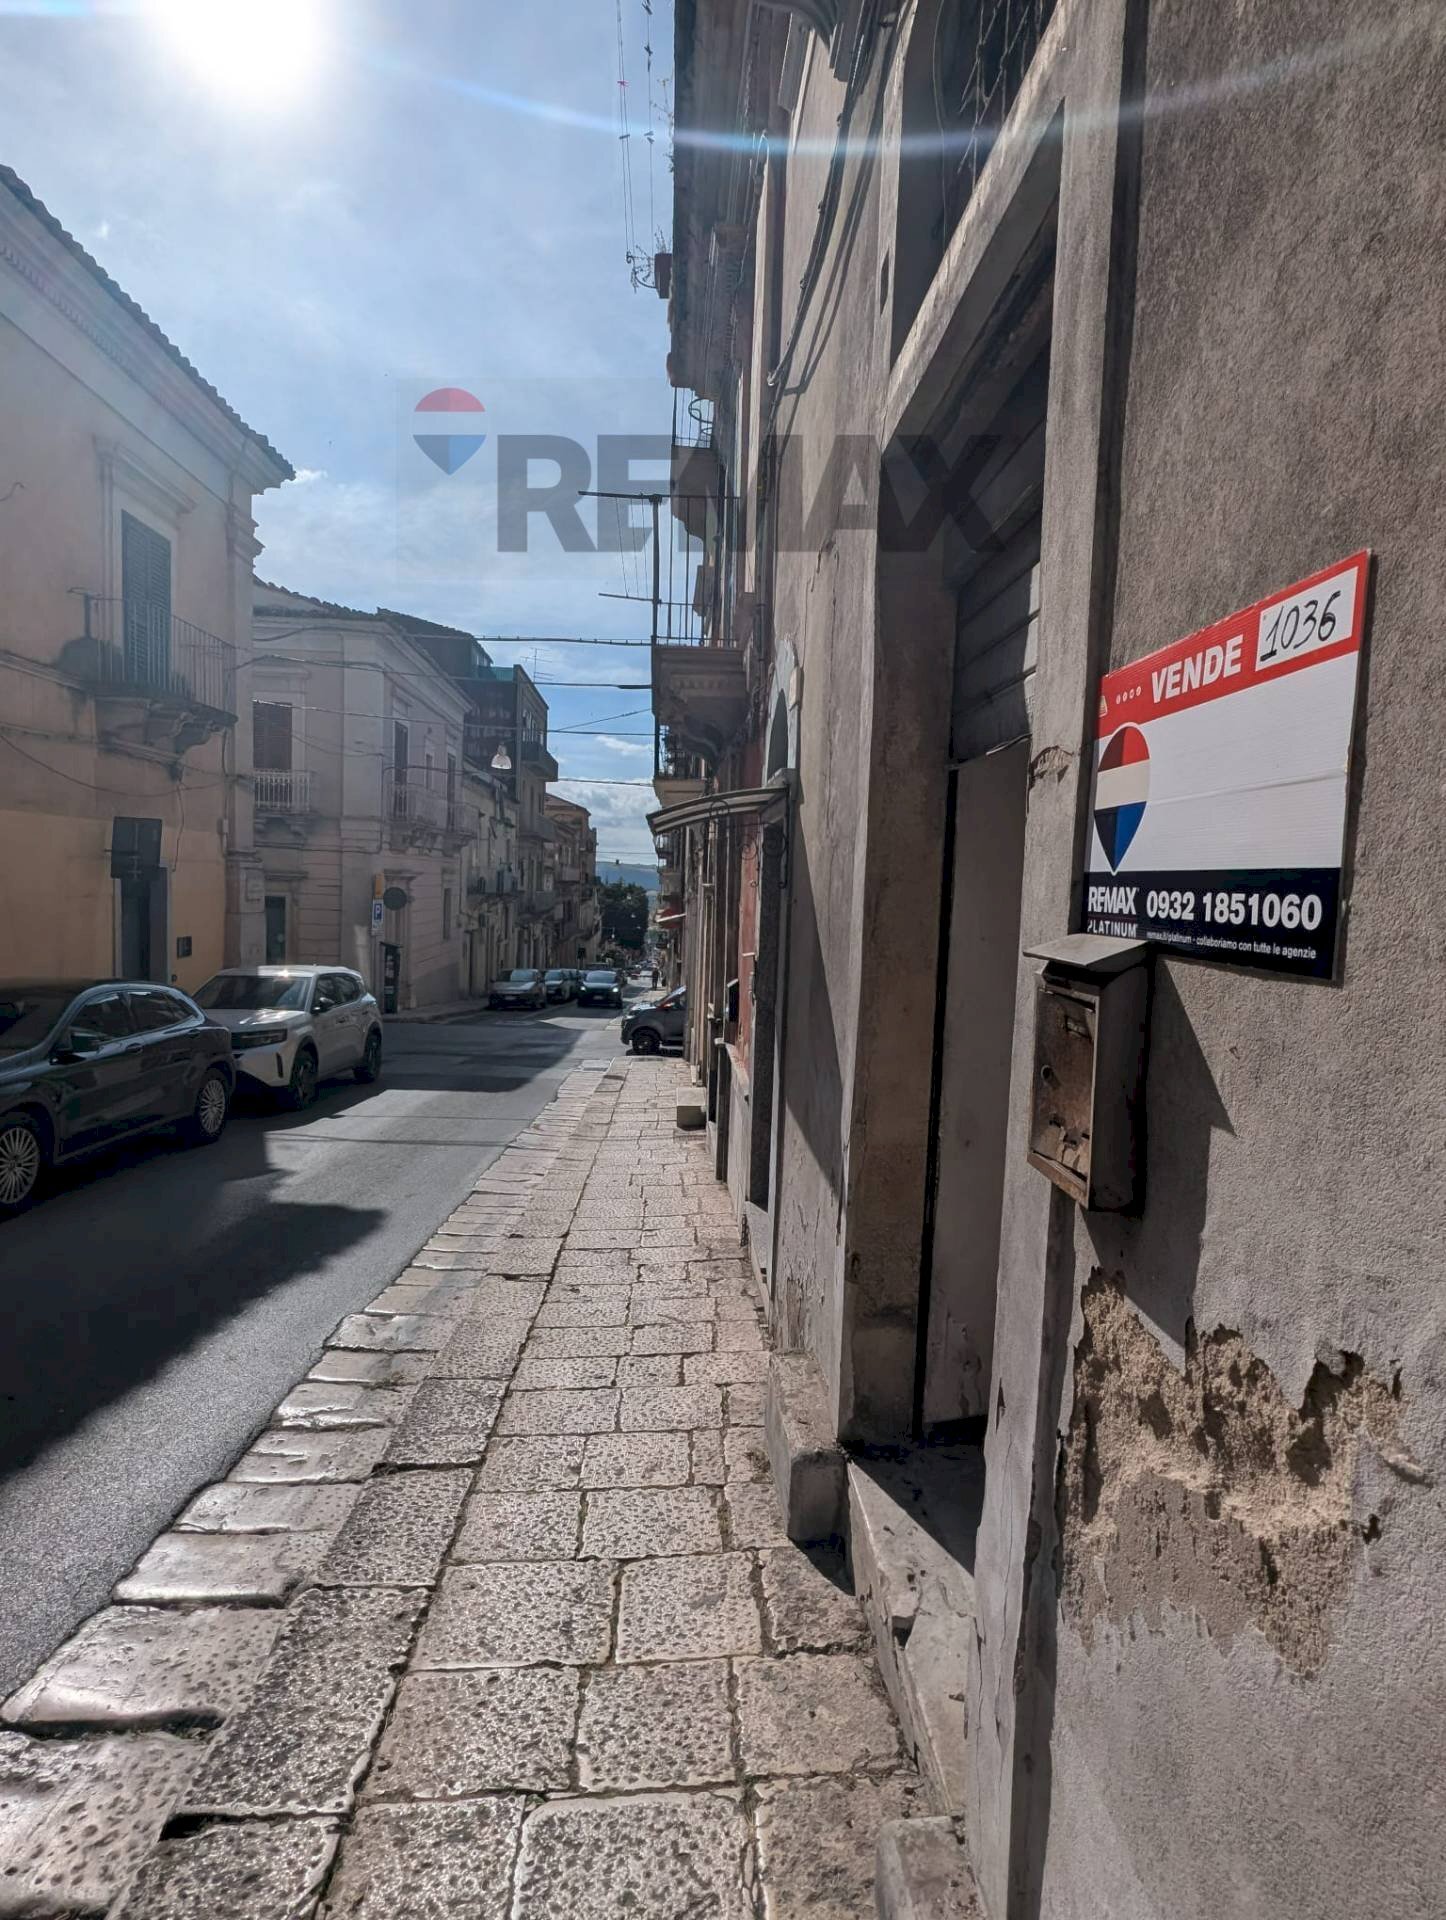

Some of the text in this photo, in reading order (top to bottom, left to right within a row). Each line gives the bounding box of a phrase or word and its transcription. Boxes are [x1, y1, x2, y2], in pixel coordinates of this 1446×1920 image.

[1260, 590, 1341, 661] 1036
[1151, 634, 1244, 704] VENDE
[1146, 890, 1323, 931] 0932 1851060
[1196, 935, 1237, 950] collaboriamo
[1239, 942, 1252, 951] con
[1253, 941, 1271, 954] tutte
[1272, 943, 1280, 955] le
[1282, 946, 1317, 959] agenzie
